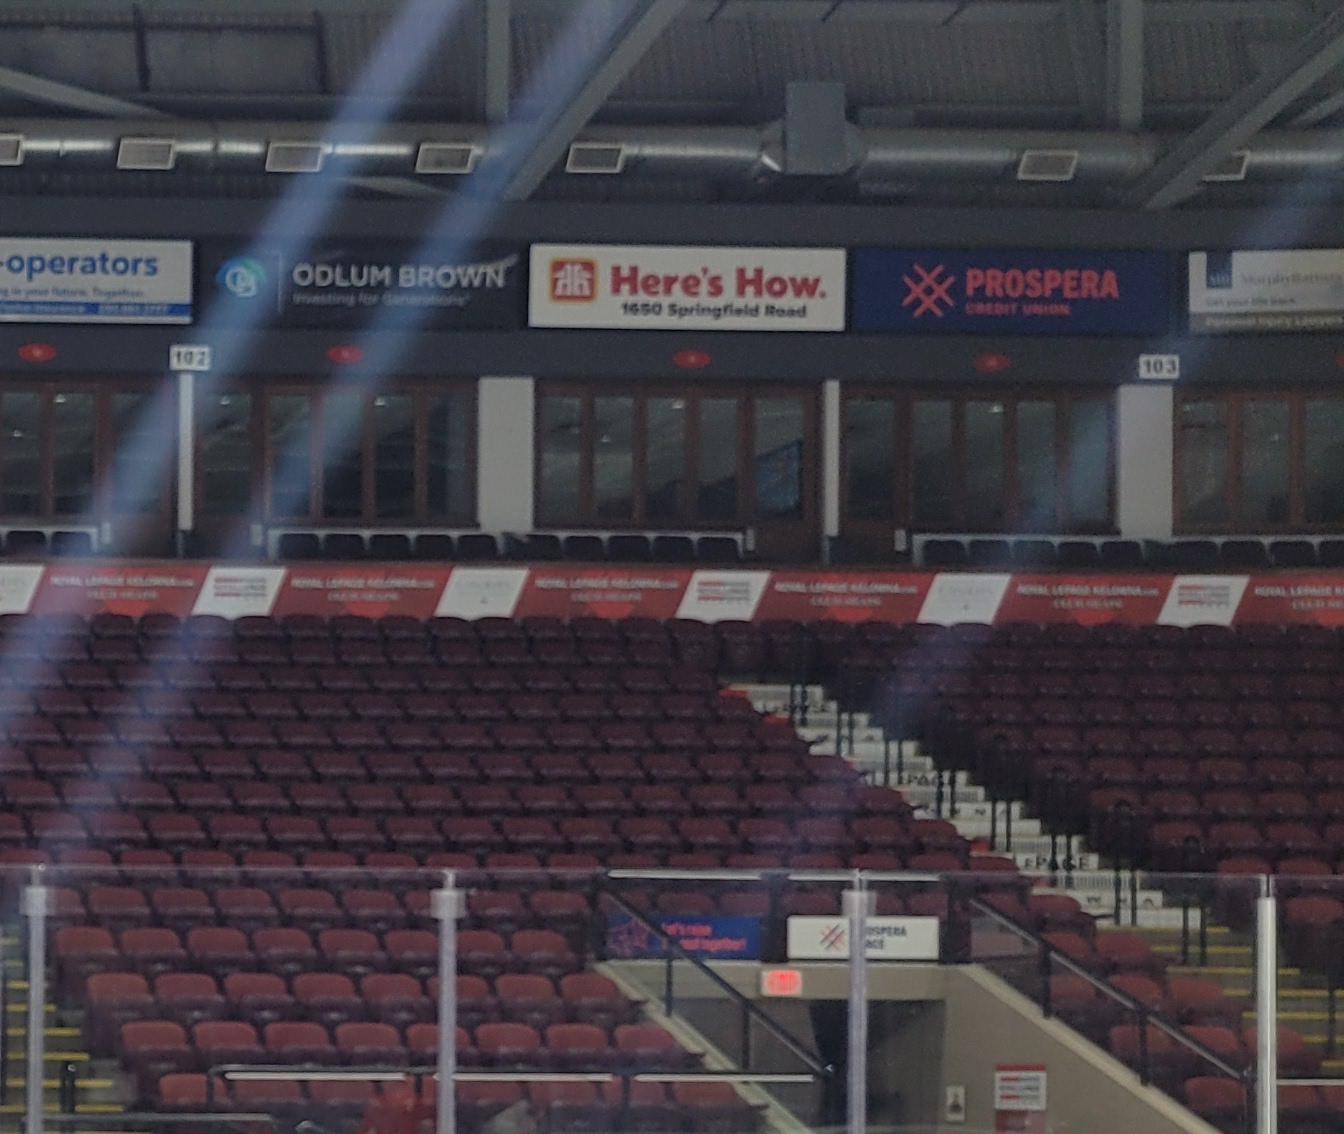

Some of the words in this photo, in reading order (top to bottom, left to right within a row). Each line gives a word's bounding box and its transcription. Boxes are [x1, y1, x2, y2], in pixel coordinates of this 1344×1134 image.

[292, 262, 391, 288] ODLUM
[398, 264, 506, 289] BROWN
[611, 265, 723, 297] Here's
[736, 266, 827, 299] How.
[965, 267, 1118, 299] PROSPERA
[622, 303, 662, 316] 1650
[667, 303, 760, 319] Springfield
[765, 304, 807, 318] Road
[966, 303, 1017, 315] CREDIT
[1023, 303, 1070, 315] UNION
